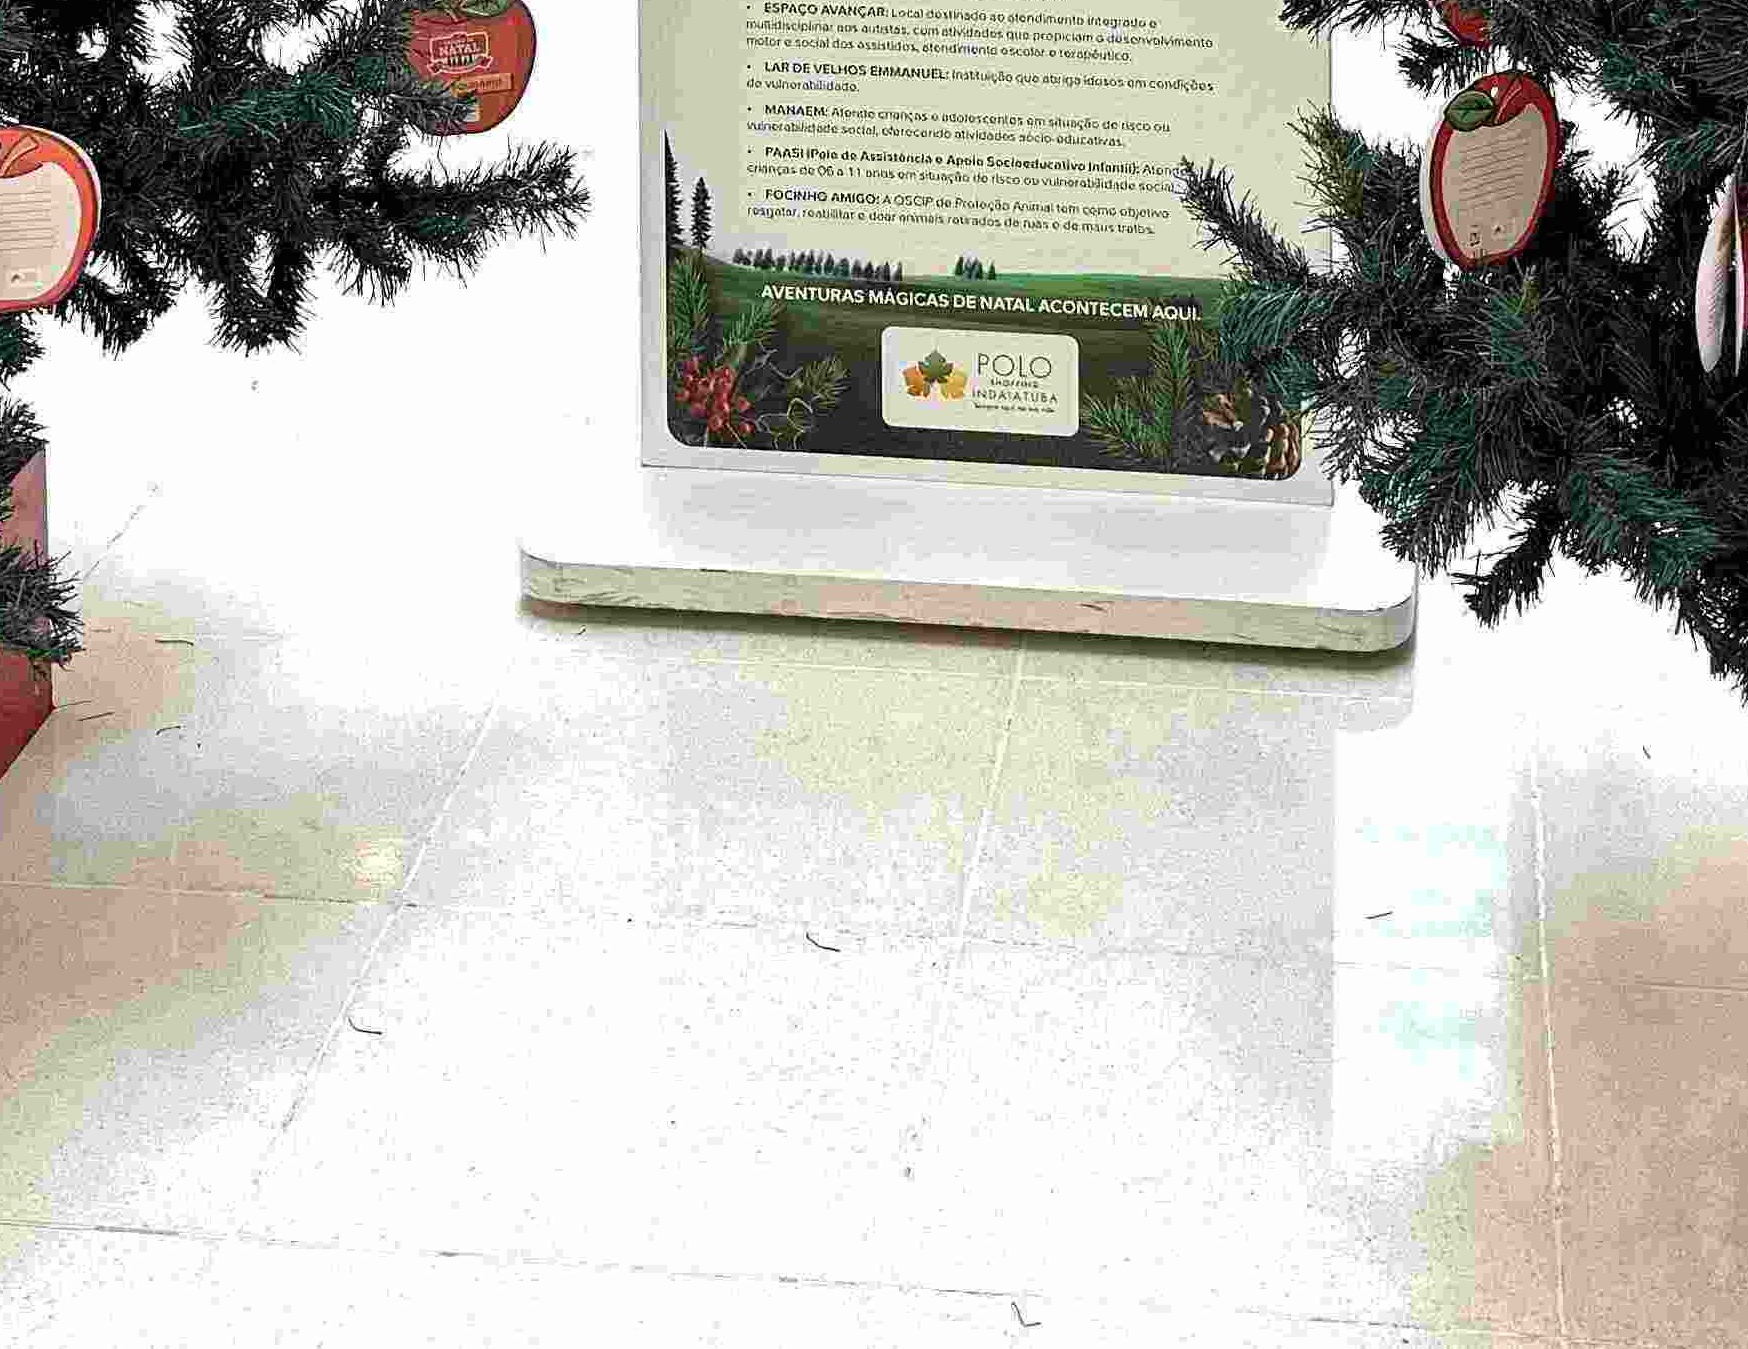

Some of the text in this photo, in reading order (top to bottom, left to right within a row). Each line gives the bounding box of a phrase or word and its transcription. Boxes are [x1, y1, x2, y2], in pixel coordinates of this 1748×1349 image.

[764, 2, 818, 16] ESPAÇO
[820, 5, 890, 18] AVANÇAR:
[438, 42, 481, 57] NATAL
[764, 61, 790, 73] LAR
[792, 62, 811, 74] DE
[814, 63, 867, 76] VELHOS
[765, 189, 828, 202] FOCINHO
[761, 284, 1202, 323] AVENTURAS MÁGICAS DE NATAL ACONTECEM AQUI.
[977, 352, 1052, 379] POLO
[971, 389, 1059, 404] INDAIATUBA
